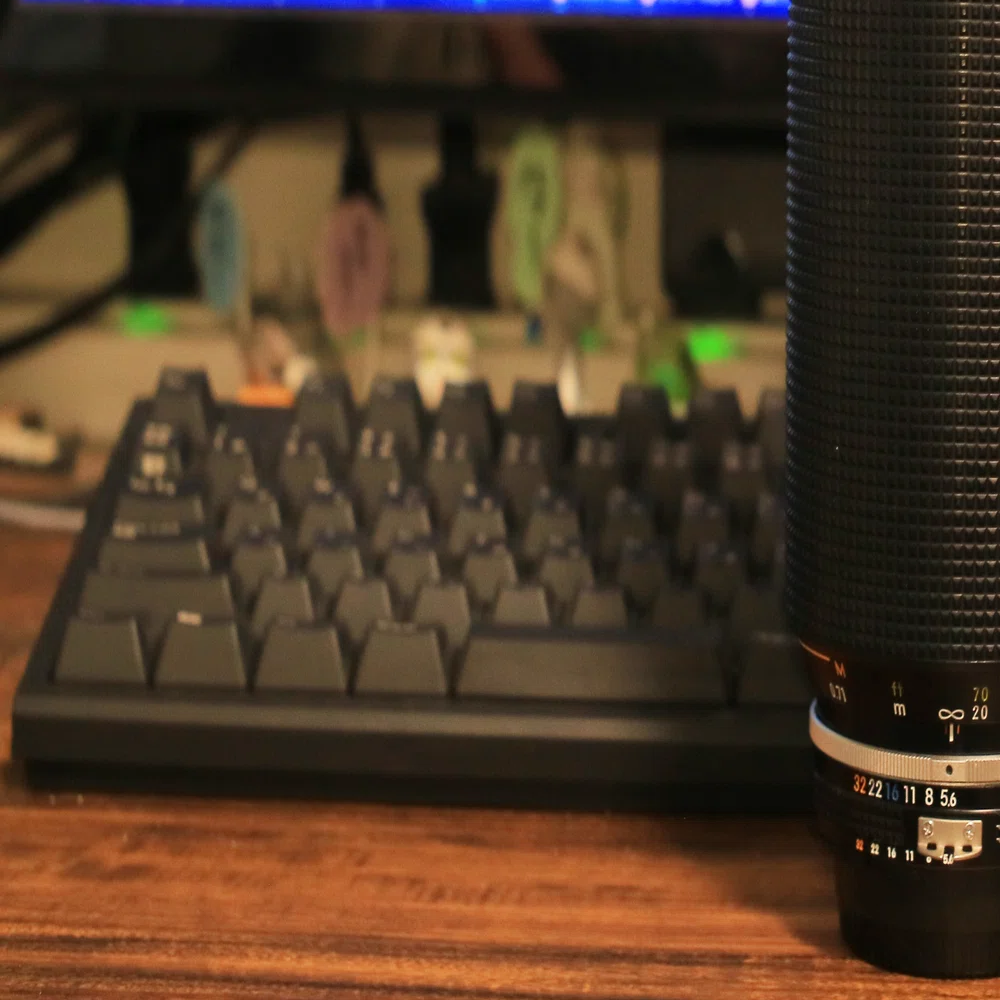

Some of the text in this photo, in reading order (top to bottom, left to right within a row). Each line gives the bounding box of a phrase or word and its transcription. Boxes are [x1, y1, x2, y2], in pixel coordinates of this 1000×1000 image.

[973, 686, 989, 702] 70
[893, 702, 906, 717] m
[972, 704, 989, 721] 20
[853, 774, 957, 808] 32 22 16 11 8 5.6
[870, 842, 880, 855] 22
[887, 846, 897, 859] 16
[905, 849, 914, 862] 11
